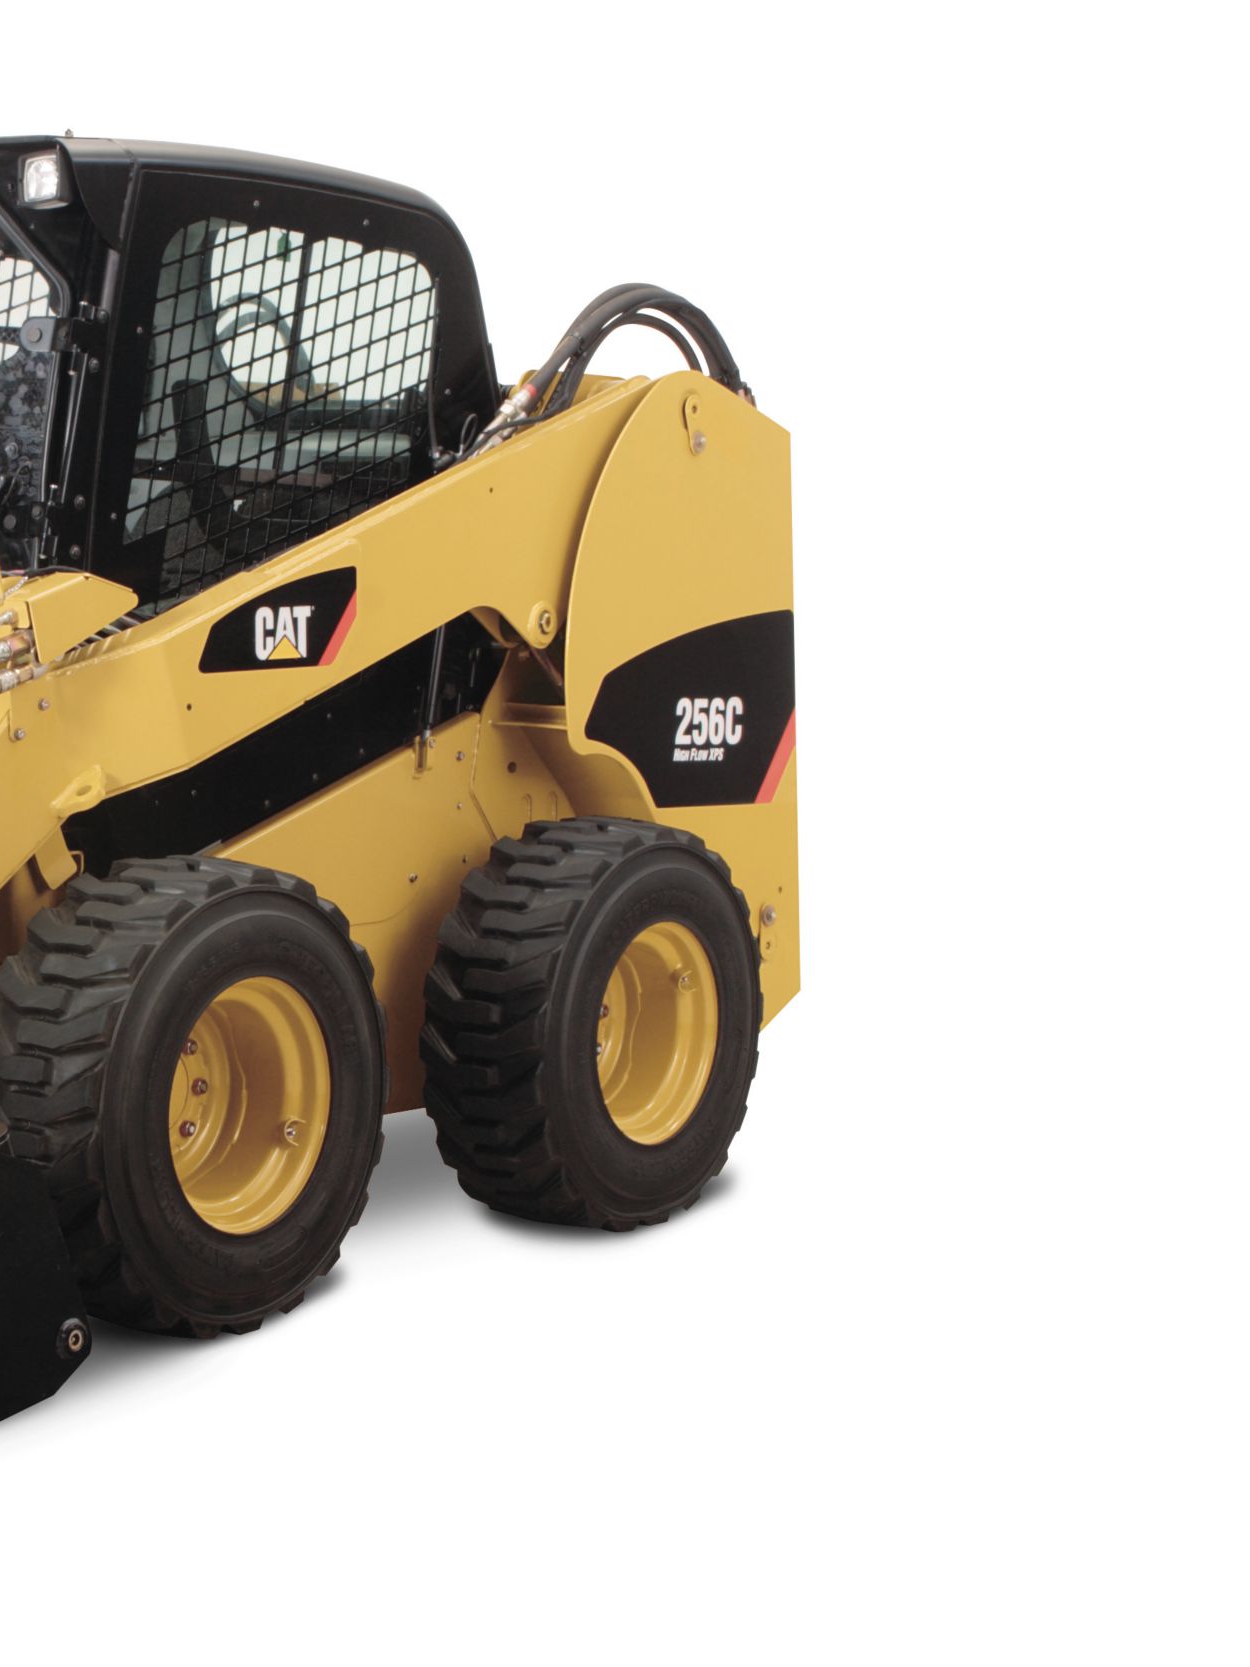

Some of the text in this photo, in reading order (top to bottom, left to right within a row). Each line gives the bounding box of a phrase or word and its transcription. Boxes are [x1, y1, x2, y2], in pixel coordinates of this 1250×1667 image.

[254, 605, 313, 661] CAT
[674, 696, 744, 746] 256C
[708, 747, 725, 762] XPS
